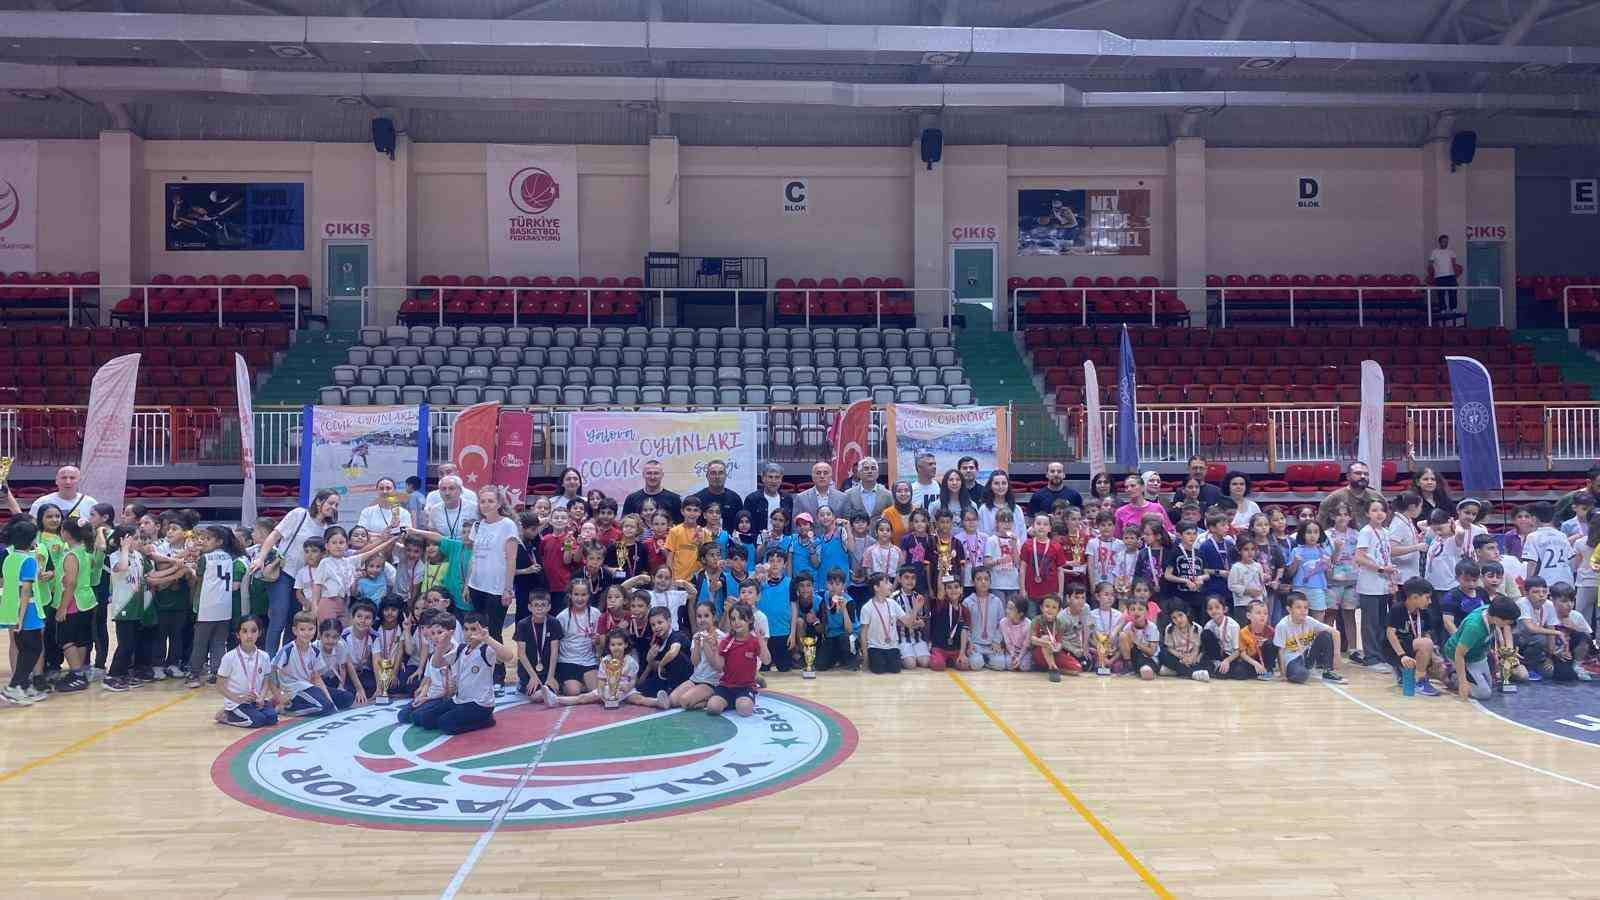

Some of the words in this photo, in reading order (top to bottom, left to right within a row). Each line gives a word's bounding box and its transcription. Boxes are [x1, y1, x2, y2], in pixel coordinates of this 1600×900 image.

[785, 181, 805, 203] C
[1300, 178, 1318, 199] D
[1576, 182, 1592, 202] E
[784, 204, 807, 212] BLOK
[325, 223, 370, 237] ÇIKIŞ
[509, 216, 560, 228] TÜRKİYE
[952, 227, 996, 241] ÇIKIŞ
[639, 432, 744, 457] OYUNLARI
[581, 457, 640, 484] ÇOCUK
[217, 565, 230, 592] 4
[281, 760, 775, 814] YALOVASPOR
